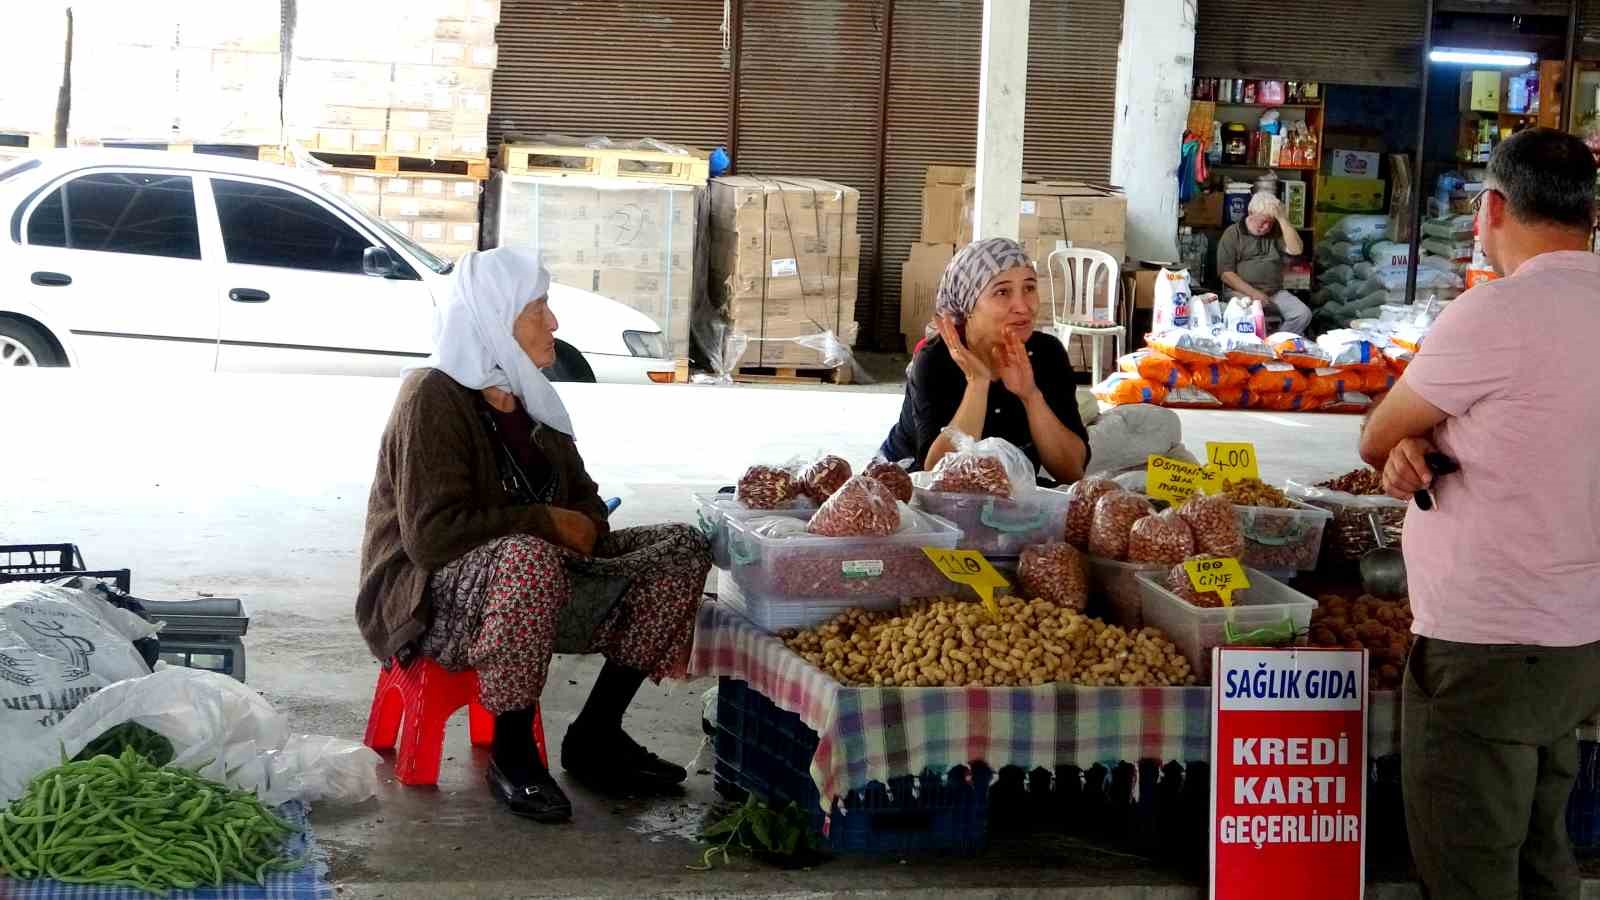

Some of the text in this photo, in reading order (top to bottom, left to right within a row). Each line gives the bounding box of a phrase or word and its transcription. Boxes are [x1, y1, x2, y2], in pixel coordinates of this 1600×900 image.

[1197, 561, 1223, 572] 100
[1225, 662, 1357, 699] SAĞLIK GIDA
[1232, 732, 1348, 766] KREDİ
[1234, 776, 1346, 804] KARTI
[1220, 809, 1360, 849] GEÇERLİDİR
